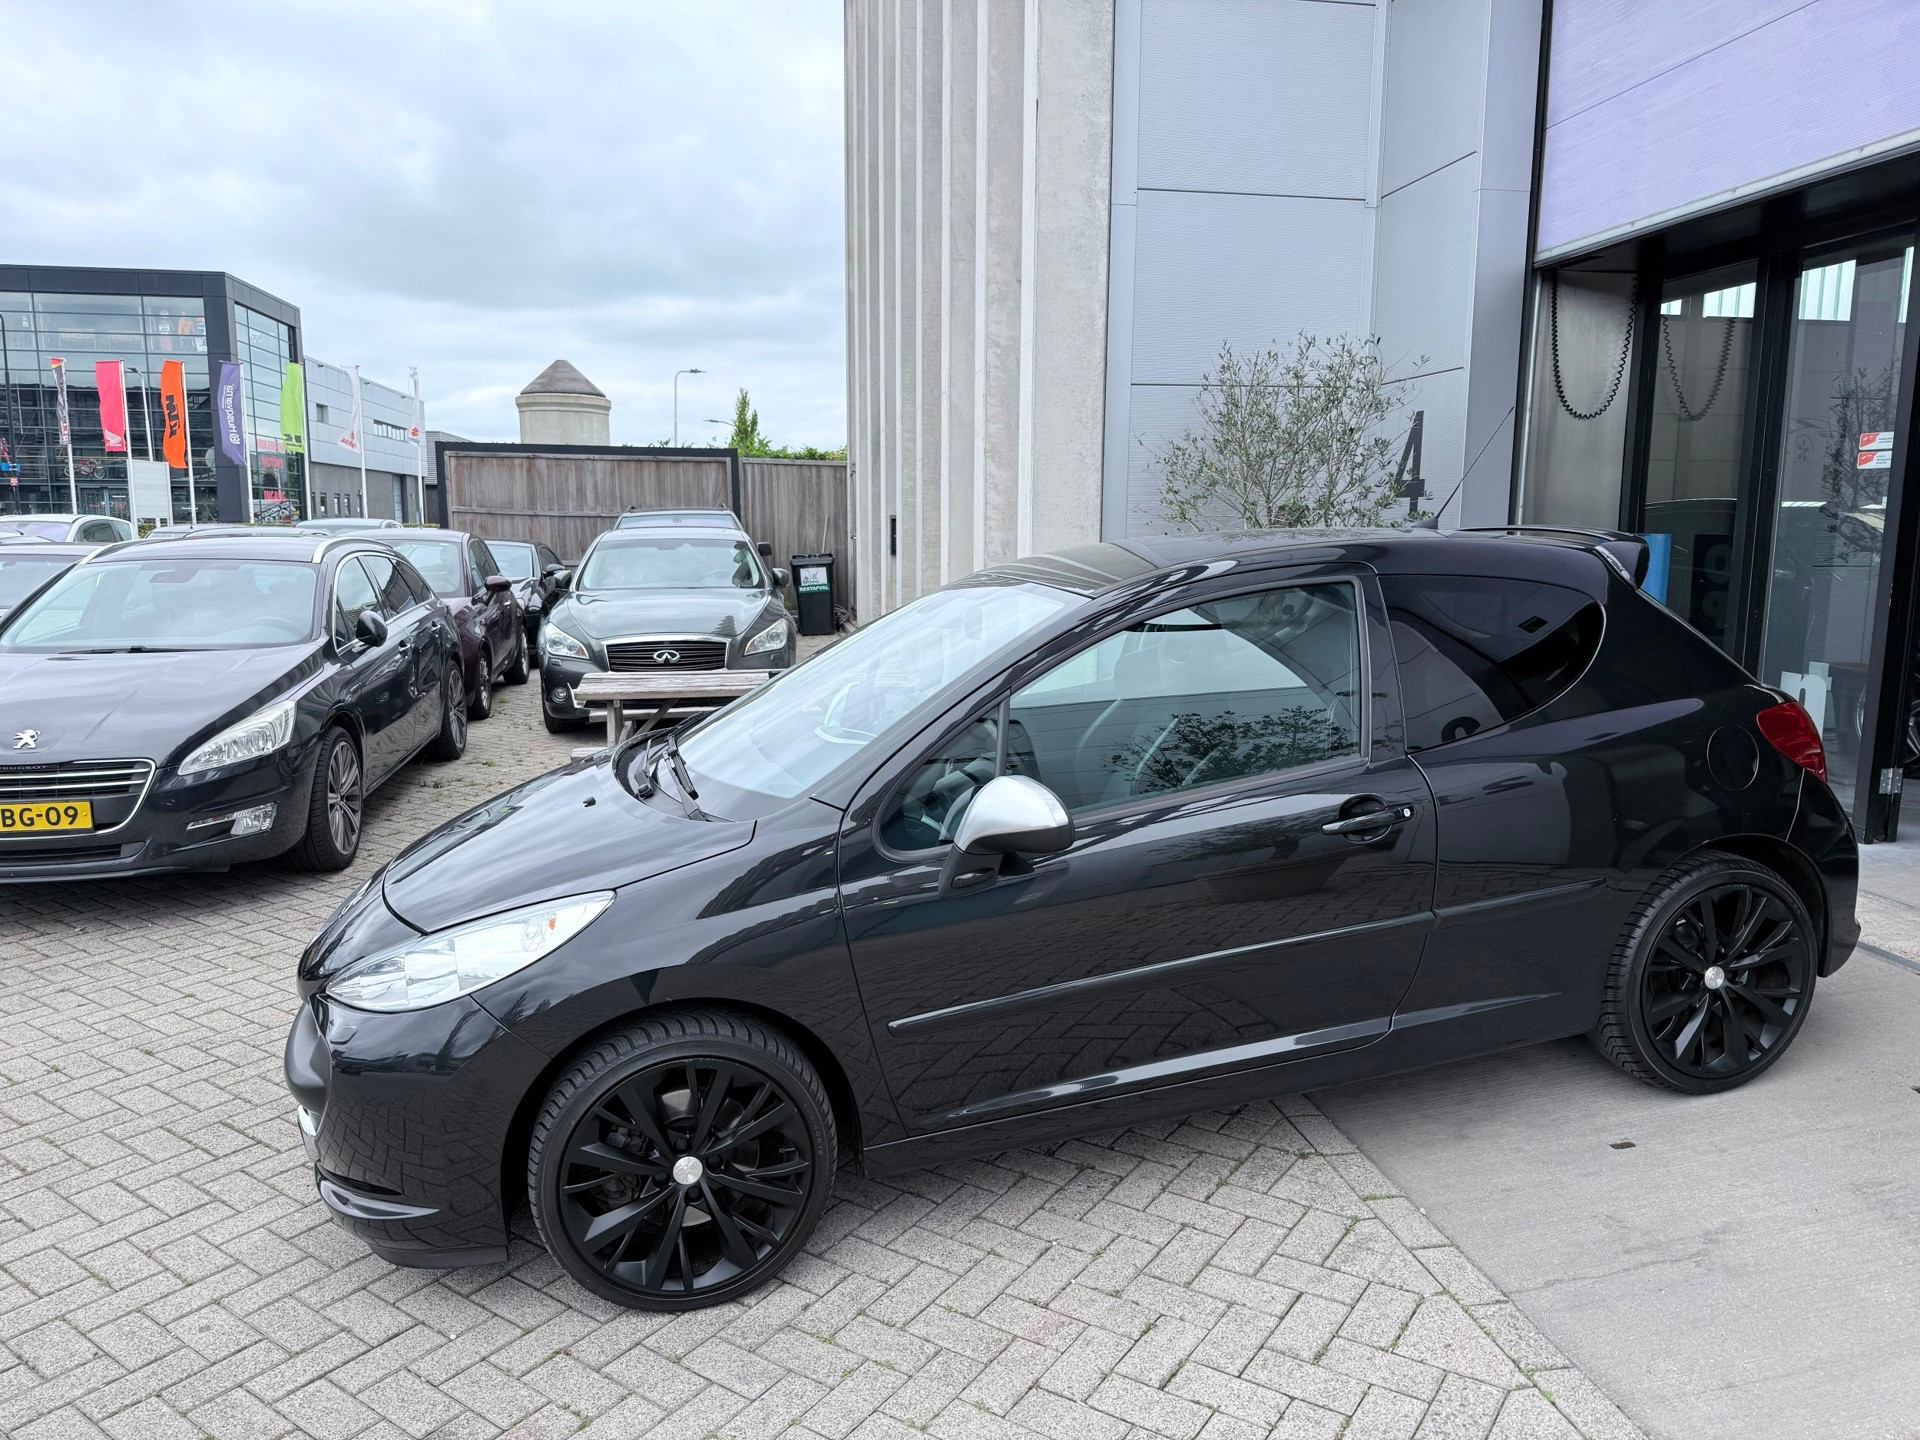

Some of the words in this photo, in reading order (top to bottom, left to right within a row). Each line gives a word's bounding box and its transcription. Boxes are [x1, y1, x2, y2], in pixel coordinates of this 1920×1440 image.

[261, 456, 284, 468] MOTORS
[1394, 410, 1425, 517] 4
[1, 806, 78, 828] BG-09
